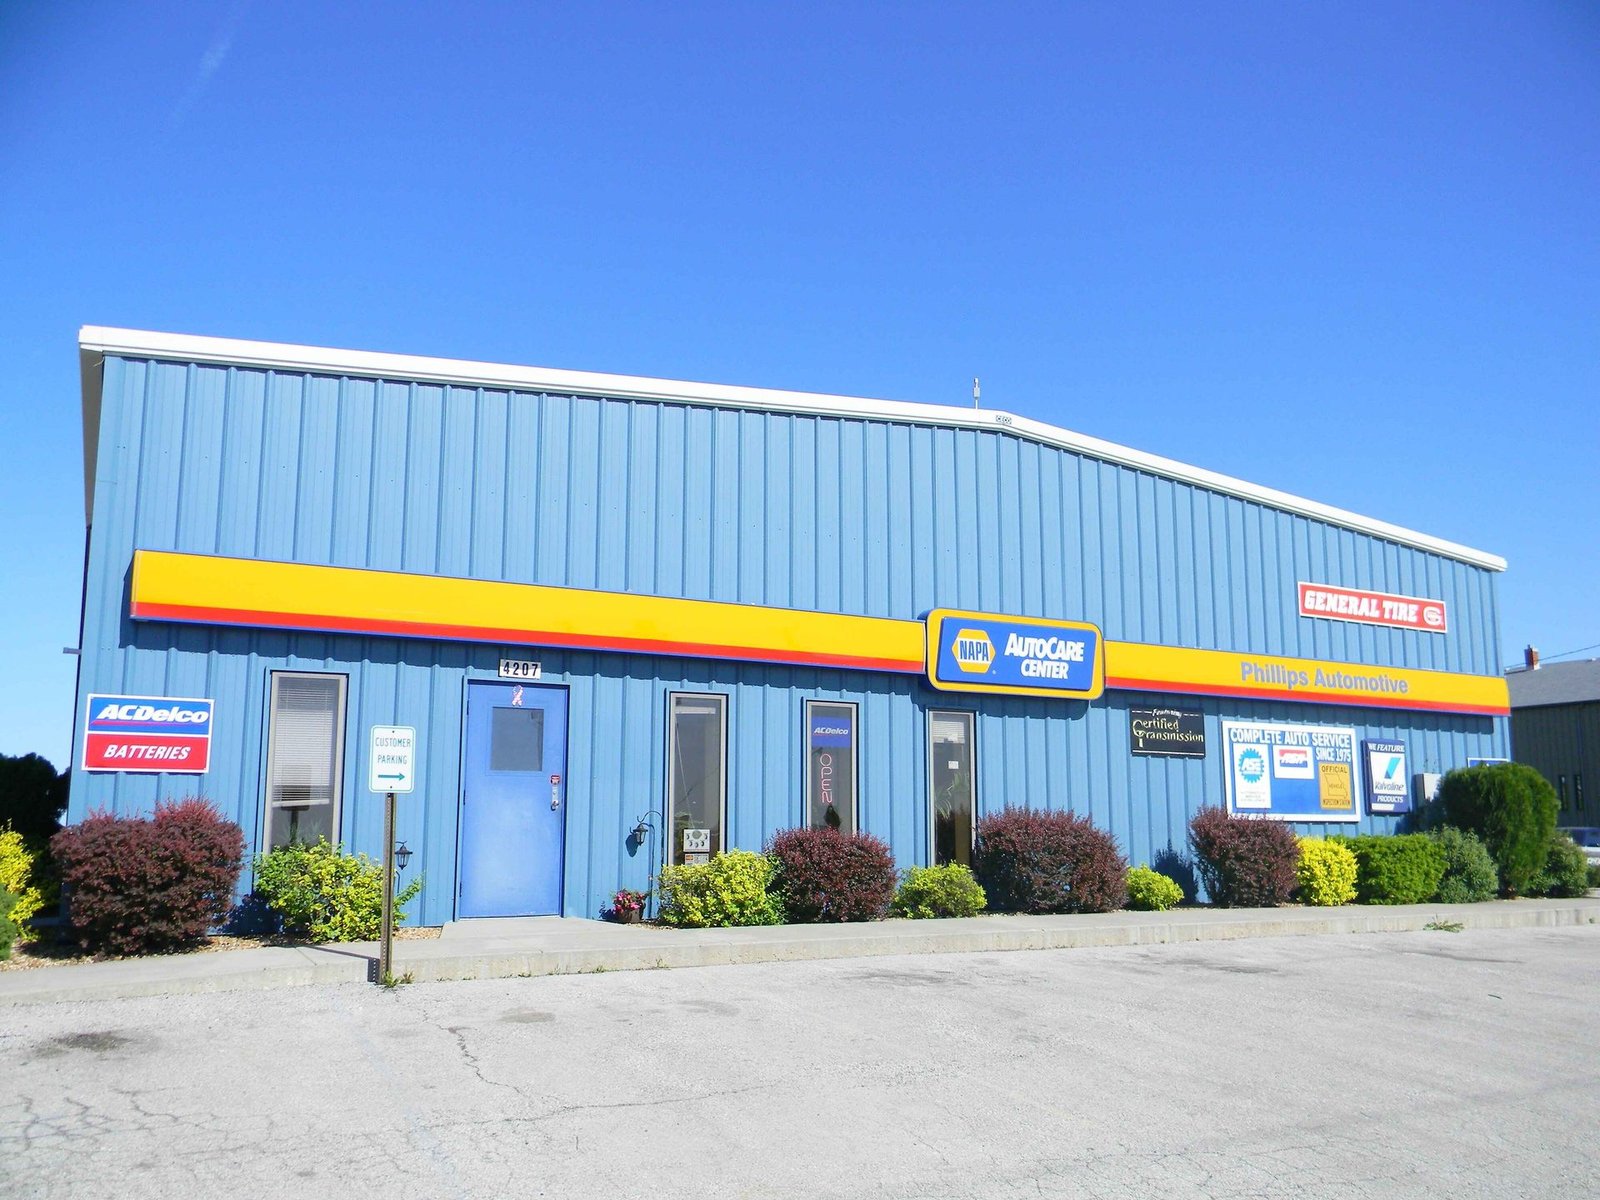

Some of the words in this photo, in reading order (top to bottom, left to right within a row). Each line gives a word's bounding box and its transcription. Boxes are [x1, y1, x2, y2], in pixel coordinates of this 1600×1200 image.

[1304, 590, 1380, 618] GENERAL
[1382, 601, 1419, 622] TIRE
[959, 639, 989, 662] NAPA
[503, 661, 539, 677] 4207
[1020, 658, 1070, 680] CENTER
[1240, 661, 1309, 690] Phillips
[1314, 668, 1409, 694] Automotive
[96, 703, 209, 723] ACDelco
[813, 726, 849, 735] ACDelco
[1132, 717, 1179, 737] Certified
[375, 737, 412, 748] CUSTOMER
[1137, 729, 1204, 748] Transmission
[1230, 728, 1282, 744] COMPLETE
[1284, 731, 1309, 746] AUTO
[1312, 733, 1351, 748] SERVICE
[103, 744, 191, 760] BATTERIES
[1315, 746, 1335, 761] SINCE
[1336, 747, 1352, 763] 1975
[1368, 743, 1377, 751] WE
[1377, 744, 1405, 753] FEATURE
[377, 754, 408, 765] PARKING
[1321, 765, 1348, 774] OFFICIAL
[819, 753, 833, 804] OPEN
[1375, 780, 1404, 792] Valvoline
[1377, 795, 1404, 803] PRODUCTS
